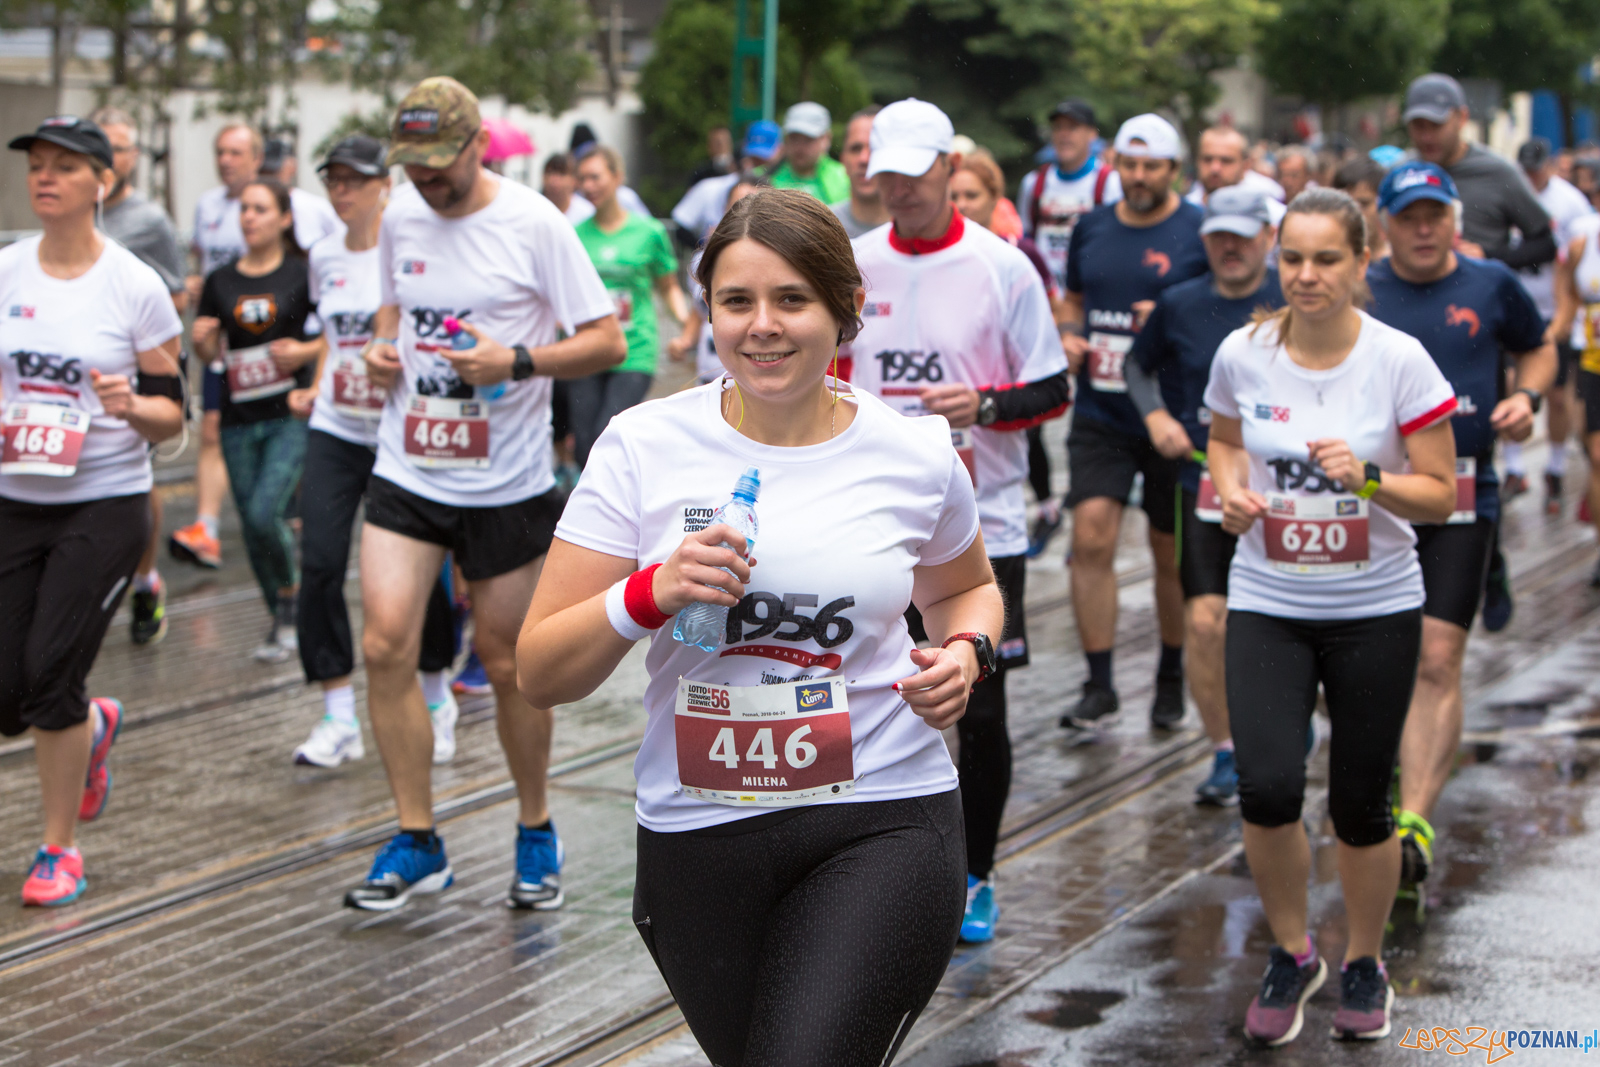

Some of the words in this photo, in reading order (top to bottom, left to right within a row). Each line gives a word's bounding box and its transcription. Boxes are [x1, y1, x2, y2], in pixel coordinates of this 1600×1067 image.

[9, 350, 82, 385] 1956
[875, 350, 944, 383] 1956
[12, 426, 66, 455] 468
[413, 420, 471, 449] 464
[684, 507, 713, 517] LOTTO
[1281, 522, 1348, 552] 620
[725, 591, 856, 648] 1956
[687, 698, 711, 707] CZERWIEC
[688, 684, 708, 694] LOTTO
[708, 724, 818, 769] 446
[742, 776, 788, 787] MILENA
